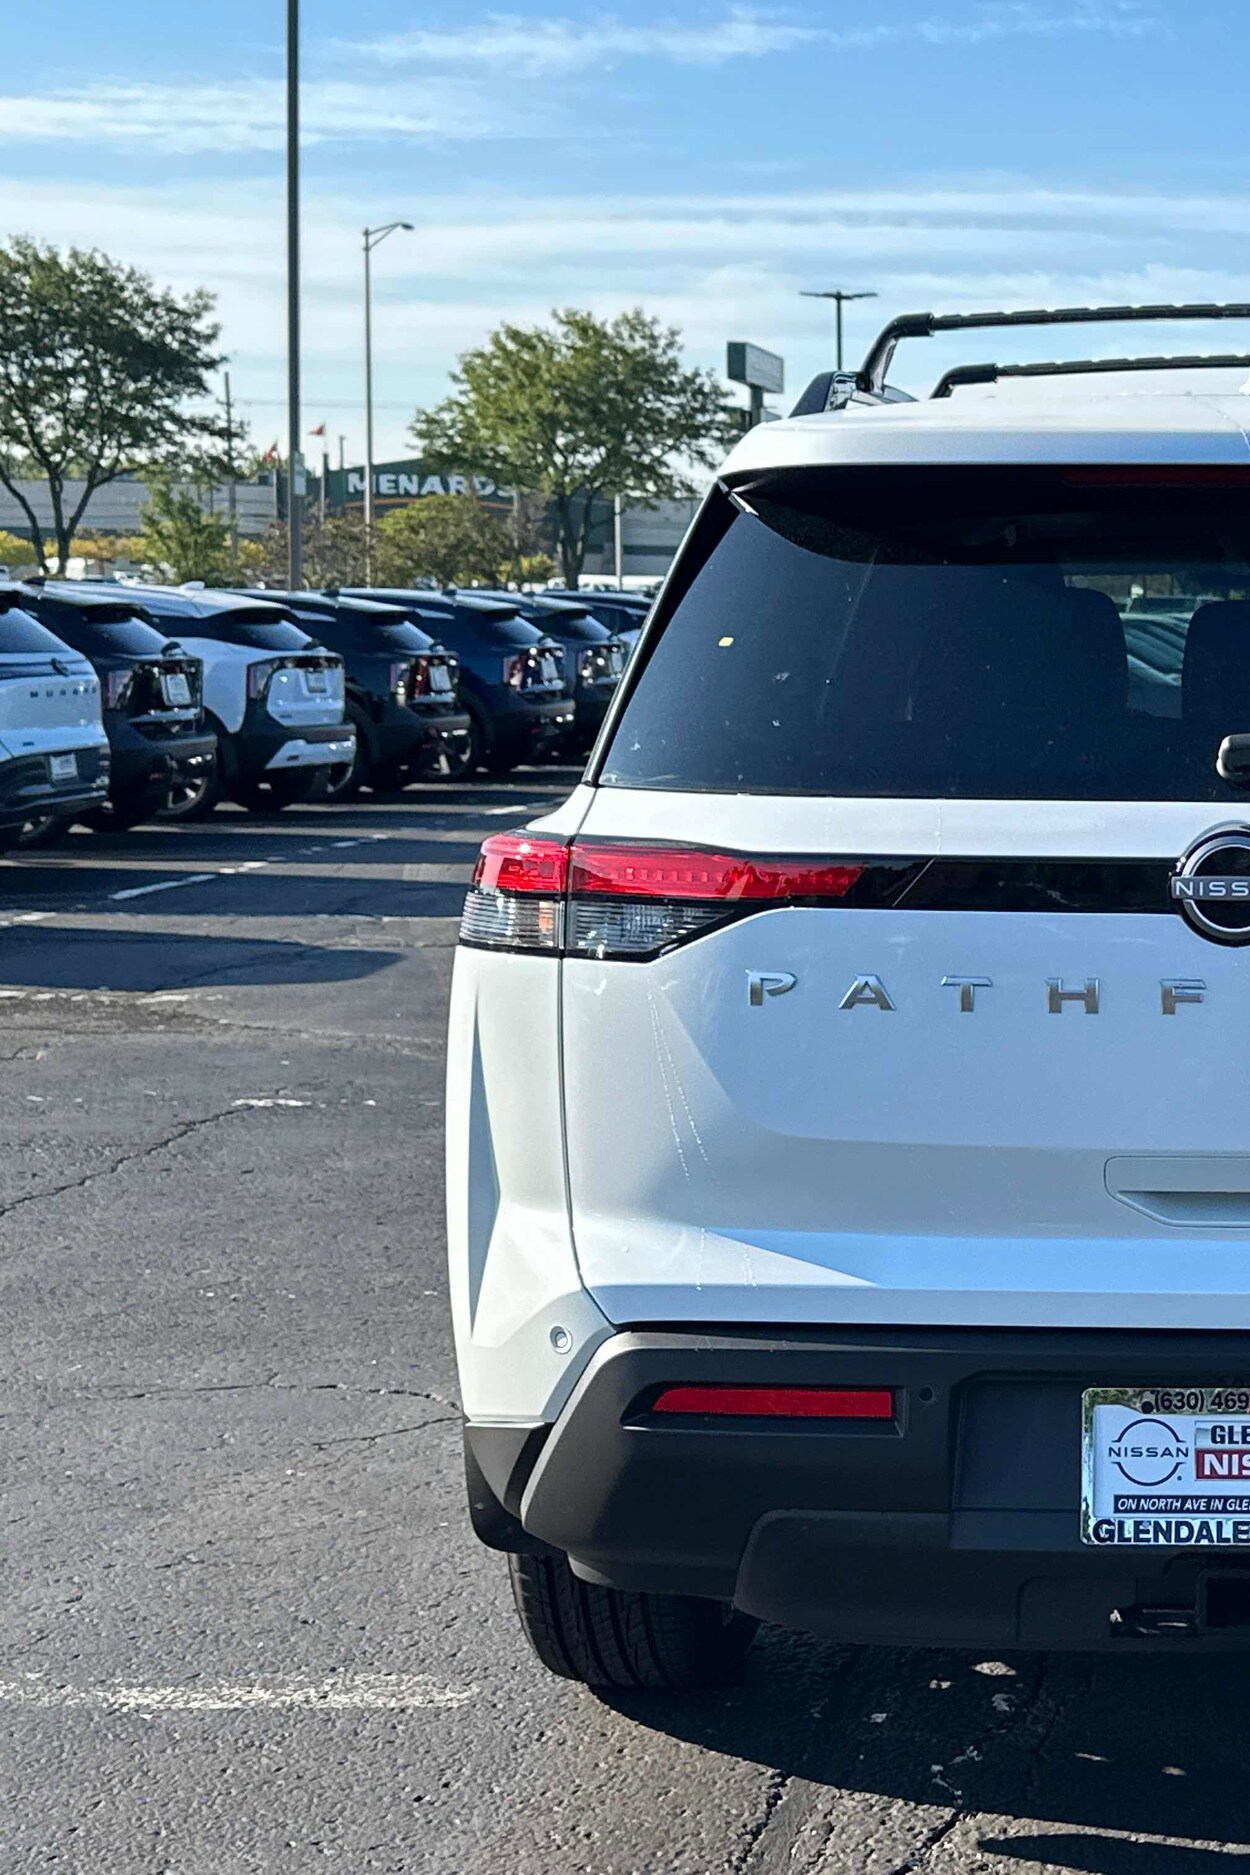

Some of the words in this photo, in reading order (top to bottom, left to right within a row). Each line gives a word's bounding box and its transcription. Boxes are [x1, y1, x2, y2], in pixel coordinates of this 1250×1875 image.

[1154, 1390, 1205, 1412] (630)
[1108, 1446, 1189, 1458] NISSAN
[1117, 1498, 1138, 1511] ON
[1138, 1498, 1182, 1511] NORTH
[1183, 1498, 1208, 1511] AVE
[1209, 1498, 1224, 1511] IN
